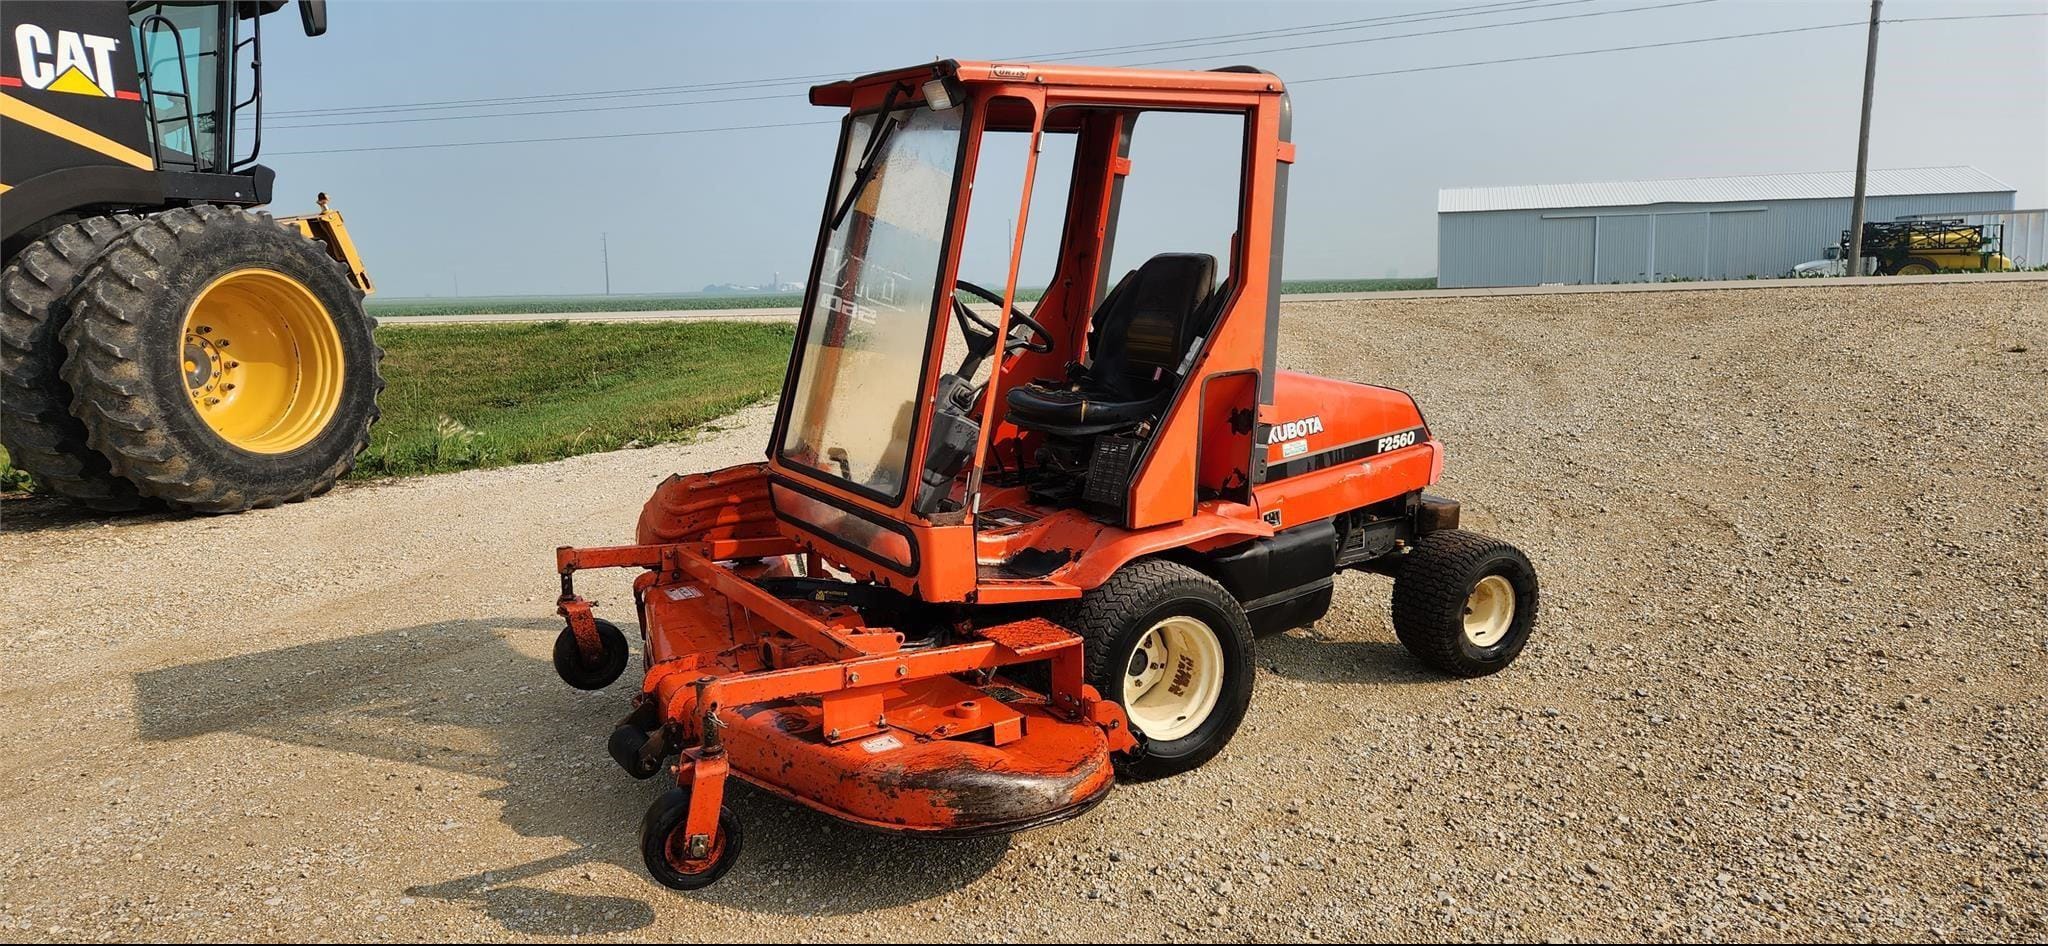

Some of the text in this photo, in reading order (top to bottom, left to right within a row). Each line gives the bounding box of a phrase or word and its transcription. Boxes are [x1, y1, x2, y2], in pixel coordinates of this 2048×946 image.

[15, 24, 117, 98] CAT
[1268, 416, 1323, 444] KUBOTA
[1377, 431, 1416, 454] F2560
